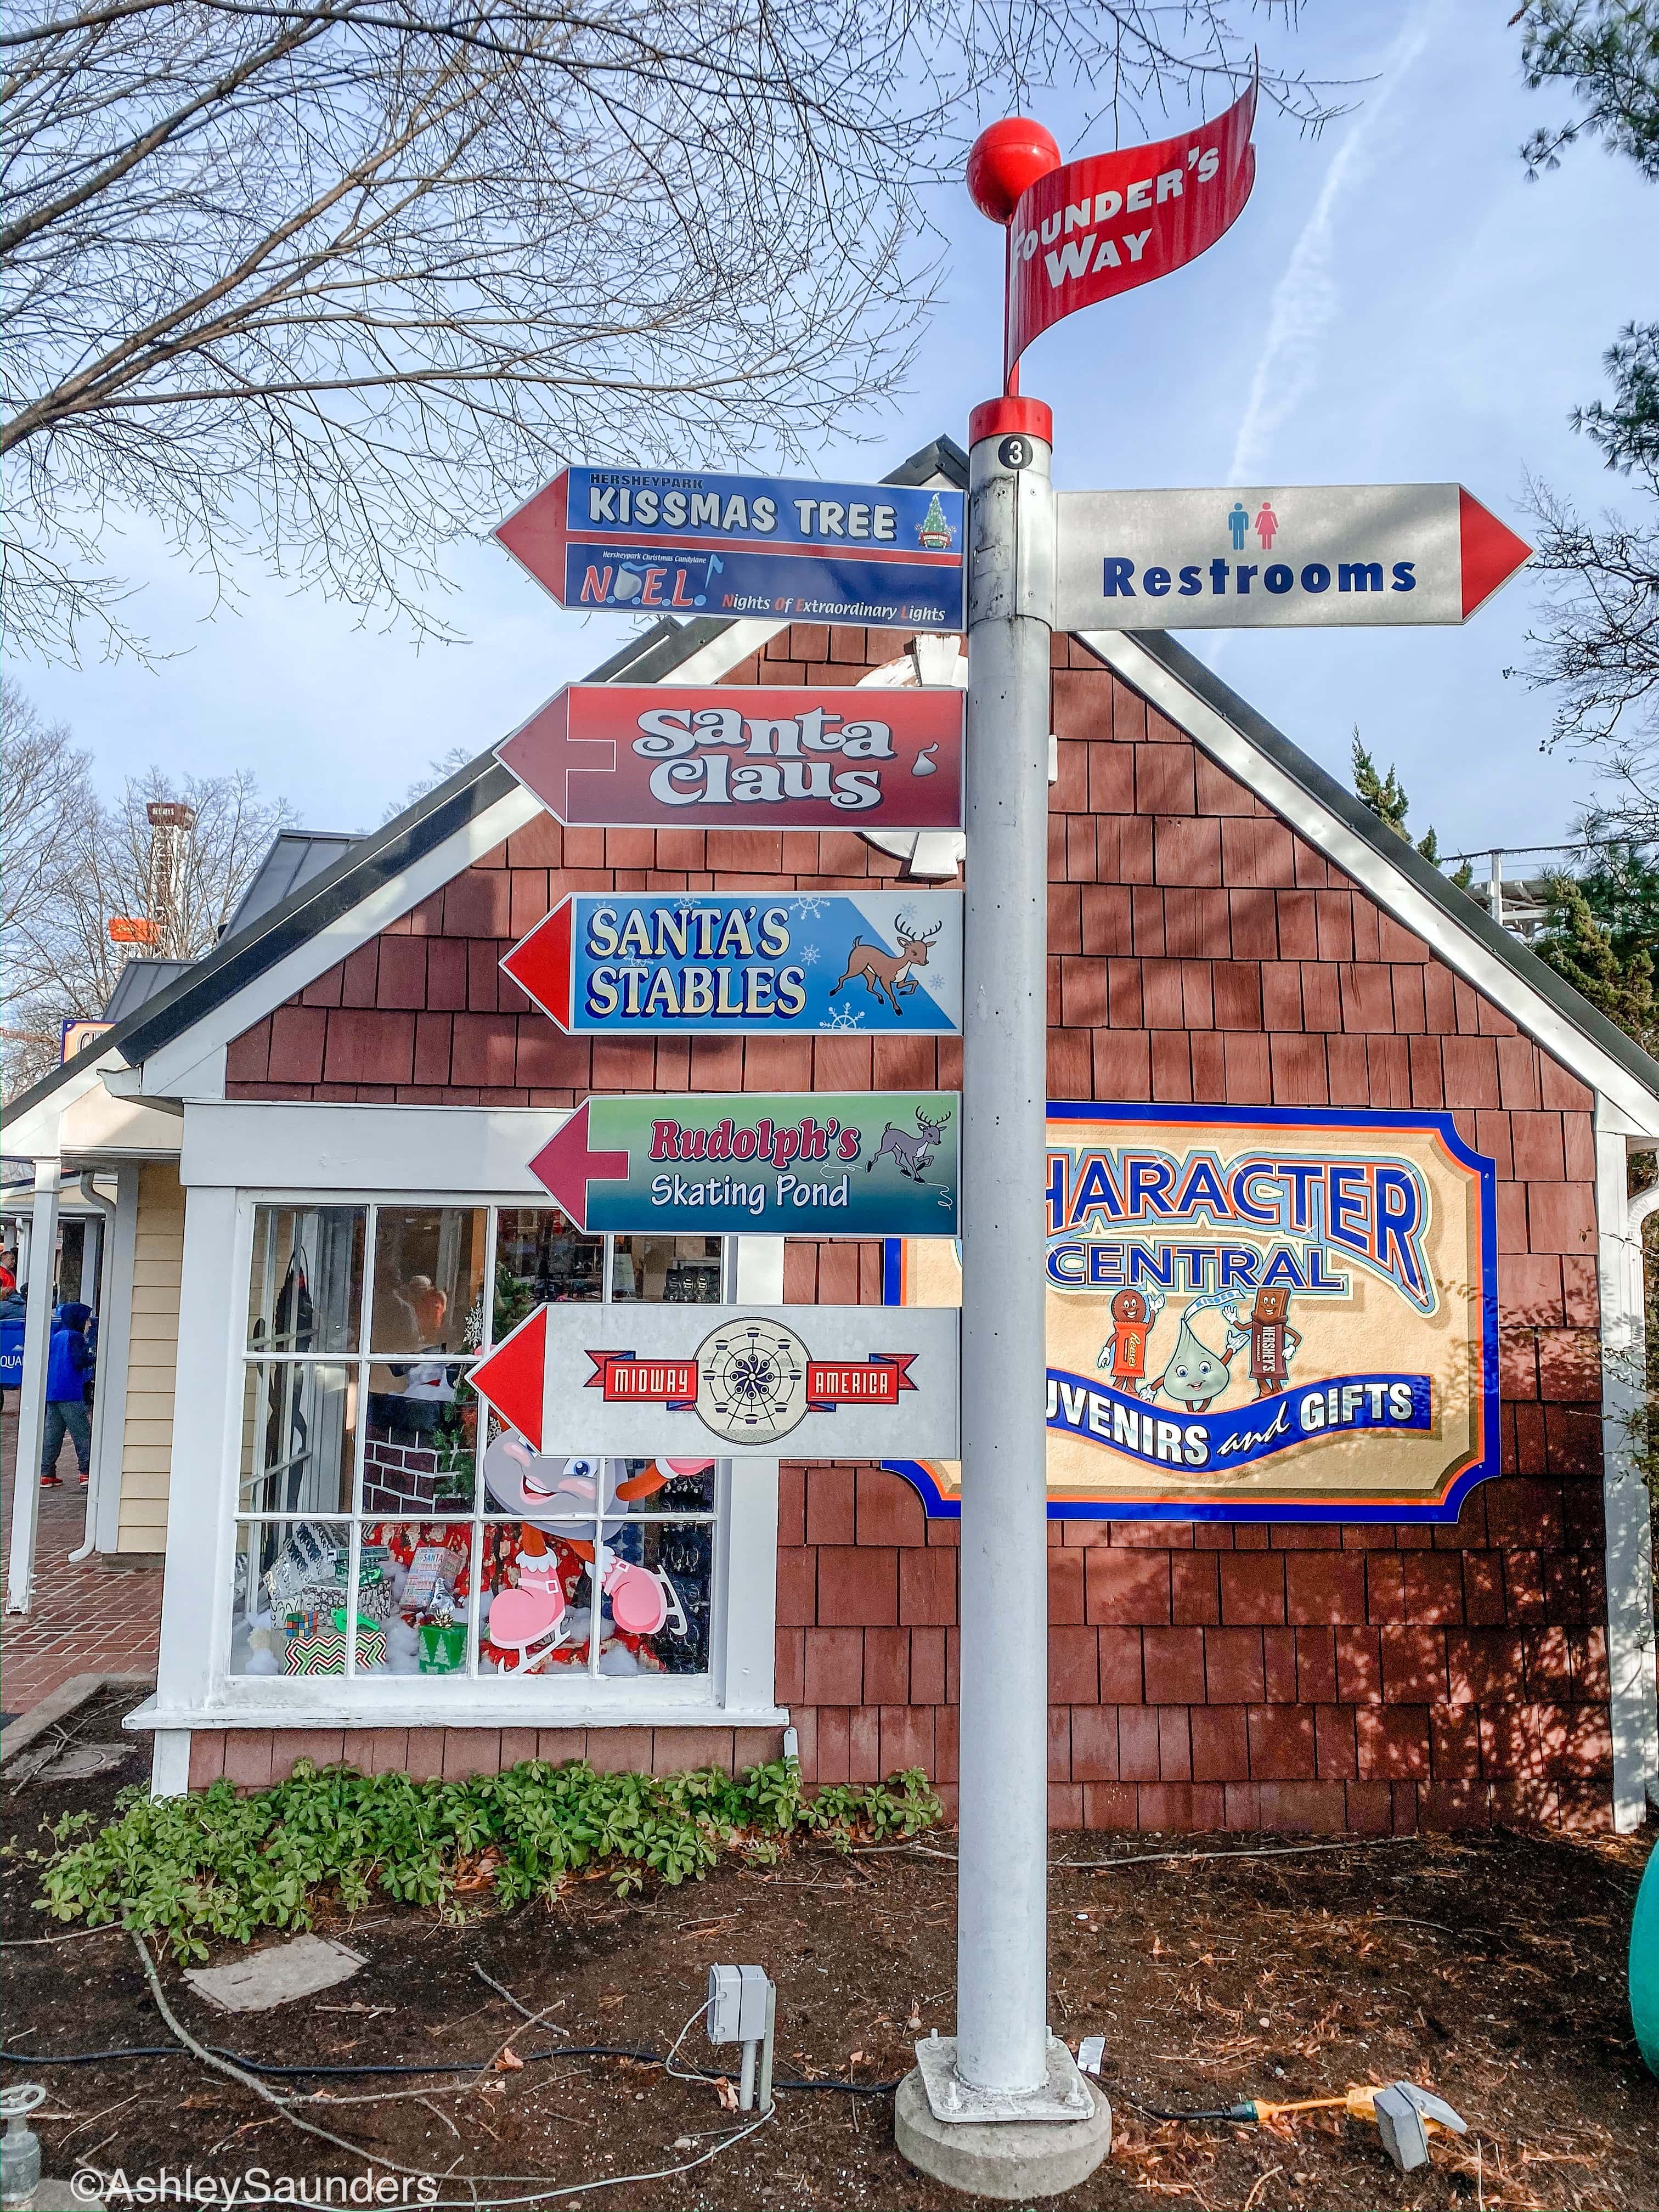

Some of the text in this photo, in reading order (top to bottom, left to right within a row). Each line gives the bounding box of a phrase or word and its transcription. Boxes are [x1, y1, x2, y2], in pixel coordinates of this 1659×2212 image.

[1012, 146, 1220, 262] FOUNDER'S
[1009, 441, 1023, 464] 3
[590, 473, 703, 489] HERSHEYPARK
[589, 486, 898, 540] KISSMAS TREE
[603, 550, 707, 563] Hersheypark Christmas Candylane
[1103, 557, 1417, 597] Restrooms
[722, 594, 945, 621] Nights Of Extraordinary Lights
[631, 706, 896, 759] Santa
[648, 754, 884, 810] Claus
[588, 906, 791, 958] SANTA'S
[587, 966, 807, 1017] STABLES
[648, 1117, 861, 1169] Rudolph's
[651, 1174, 849, 1215] Skating Pond
[1046, 1243, 1344, 1290] CENTRAL
[1195, 1291, 1235, 1308] KISSES
[1262, 1326, 1276, 1372] HERSHEY'S
[614, 1368, 889, 1395] MIDWAY AMERICA
[1217, 1401, 1291, 1457] and
[1300, 1383, 1413, 1434] GIFTS
